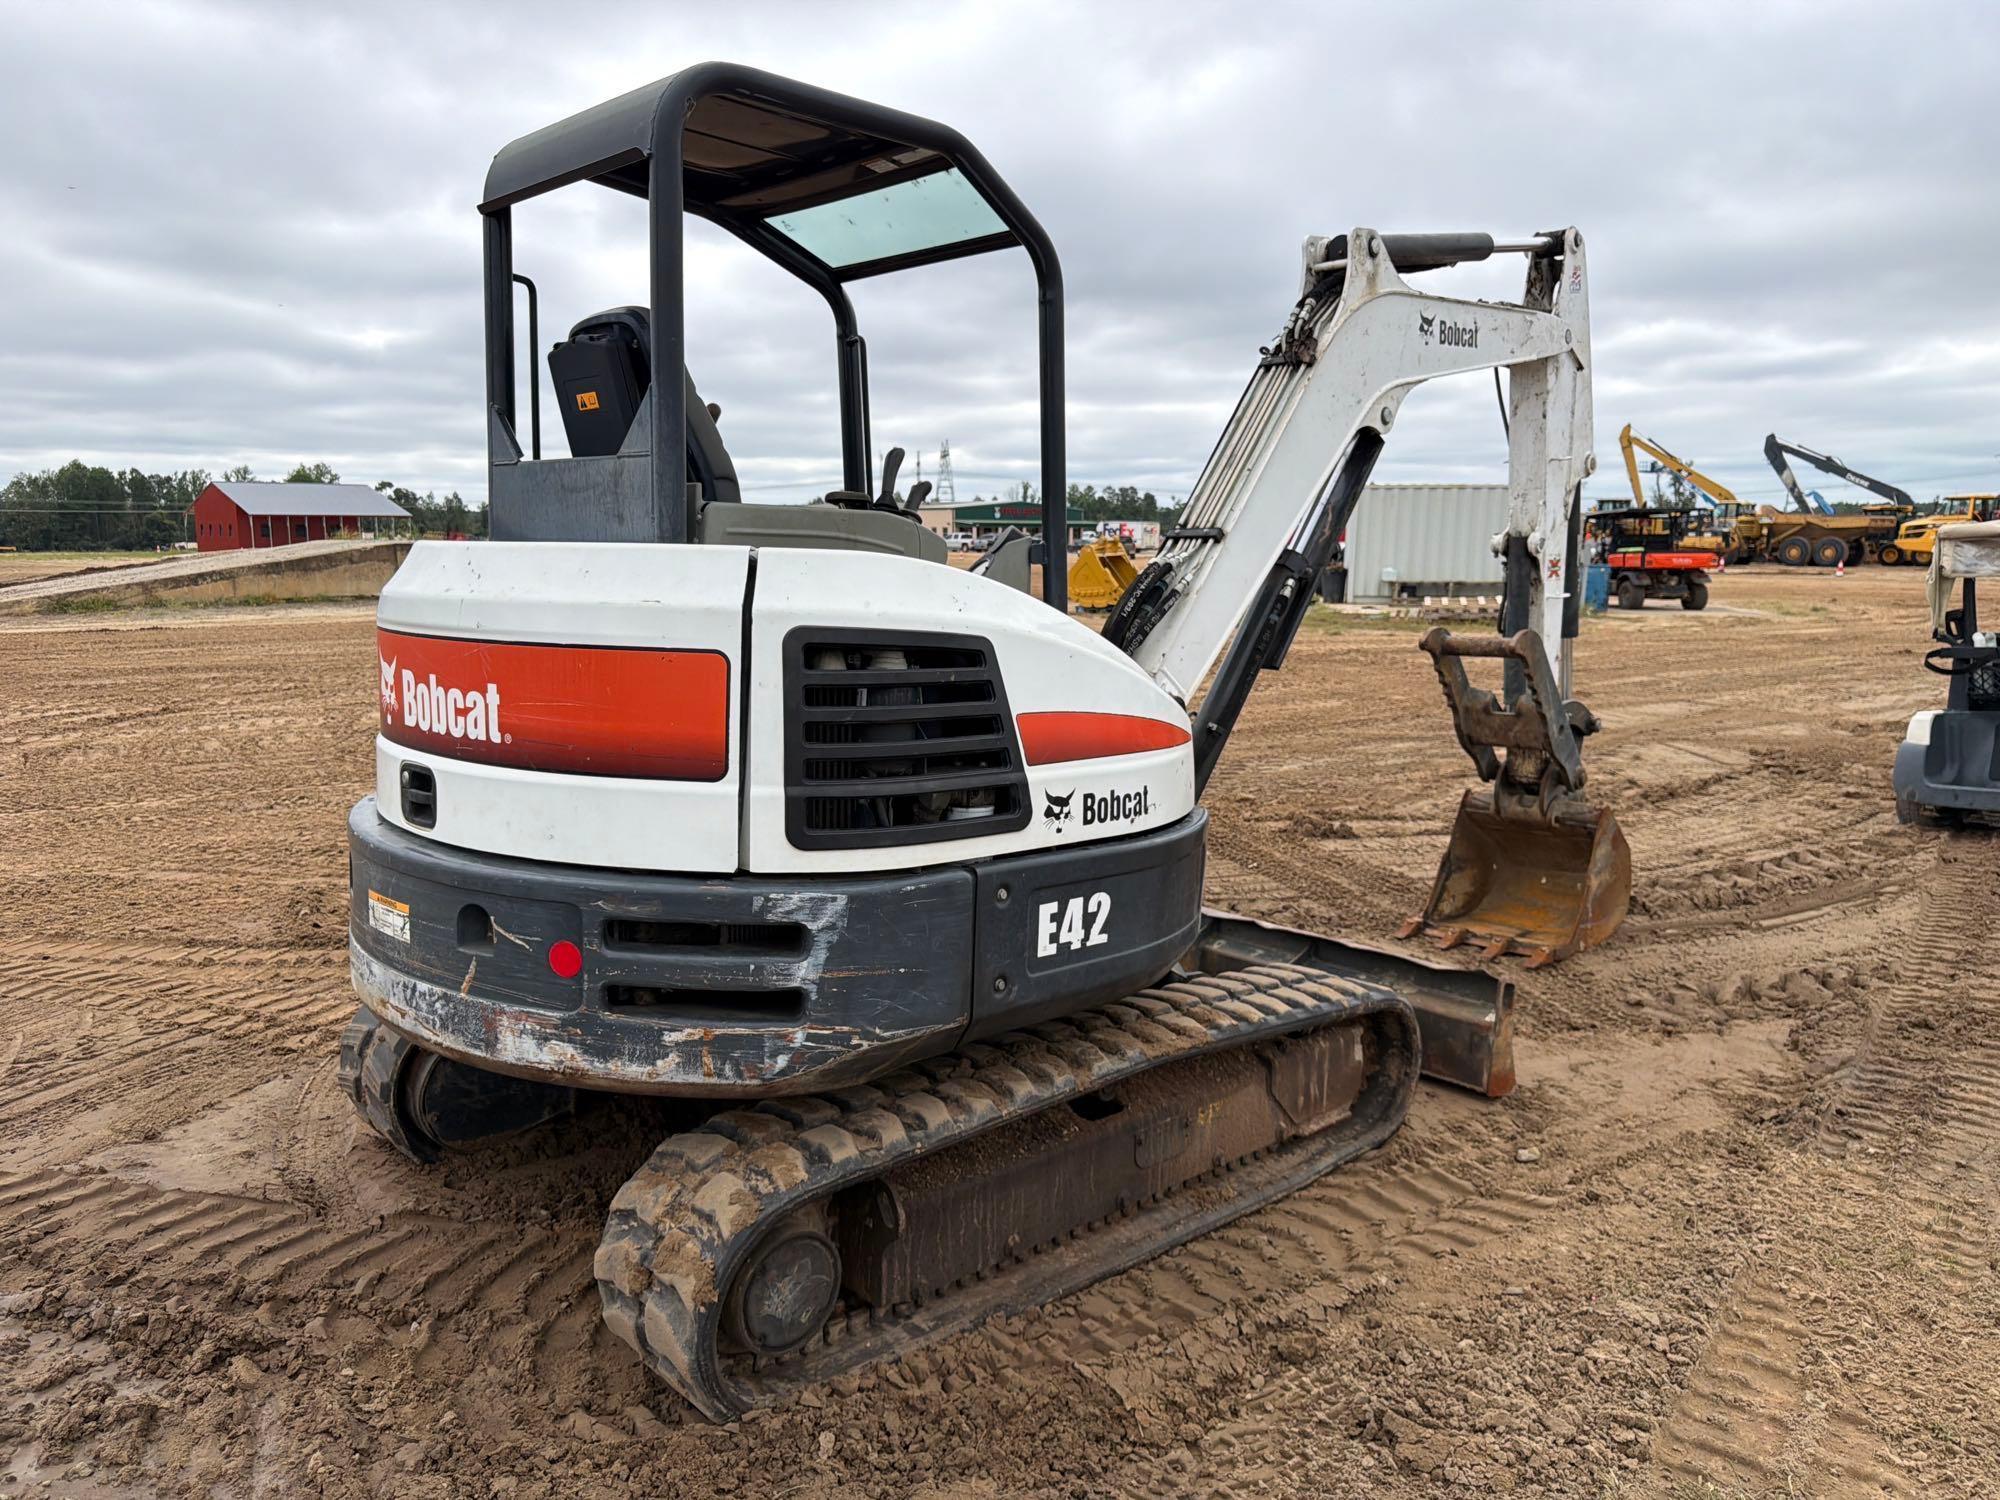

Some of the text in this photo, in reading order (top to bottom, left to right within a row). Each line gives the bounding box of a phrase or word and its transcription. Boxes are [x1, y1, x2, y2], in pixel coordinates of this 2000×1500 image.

[1439, 320, 1479, 349] Bobcat
[1103, 522, 1135, 538] FedEx
[401, 669, 502, 744] Bobcat
[1082, 785, 1150, 826] Bobcat
[1037, 891, 1112, 958] E42
